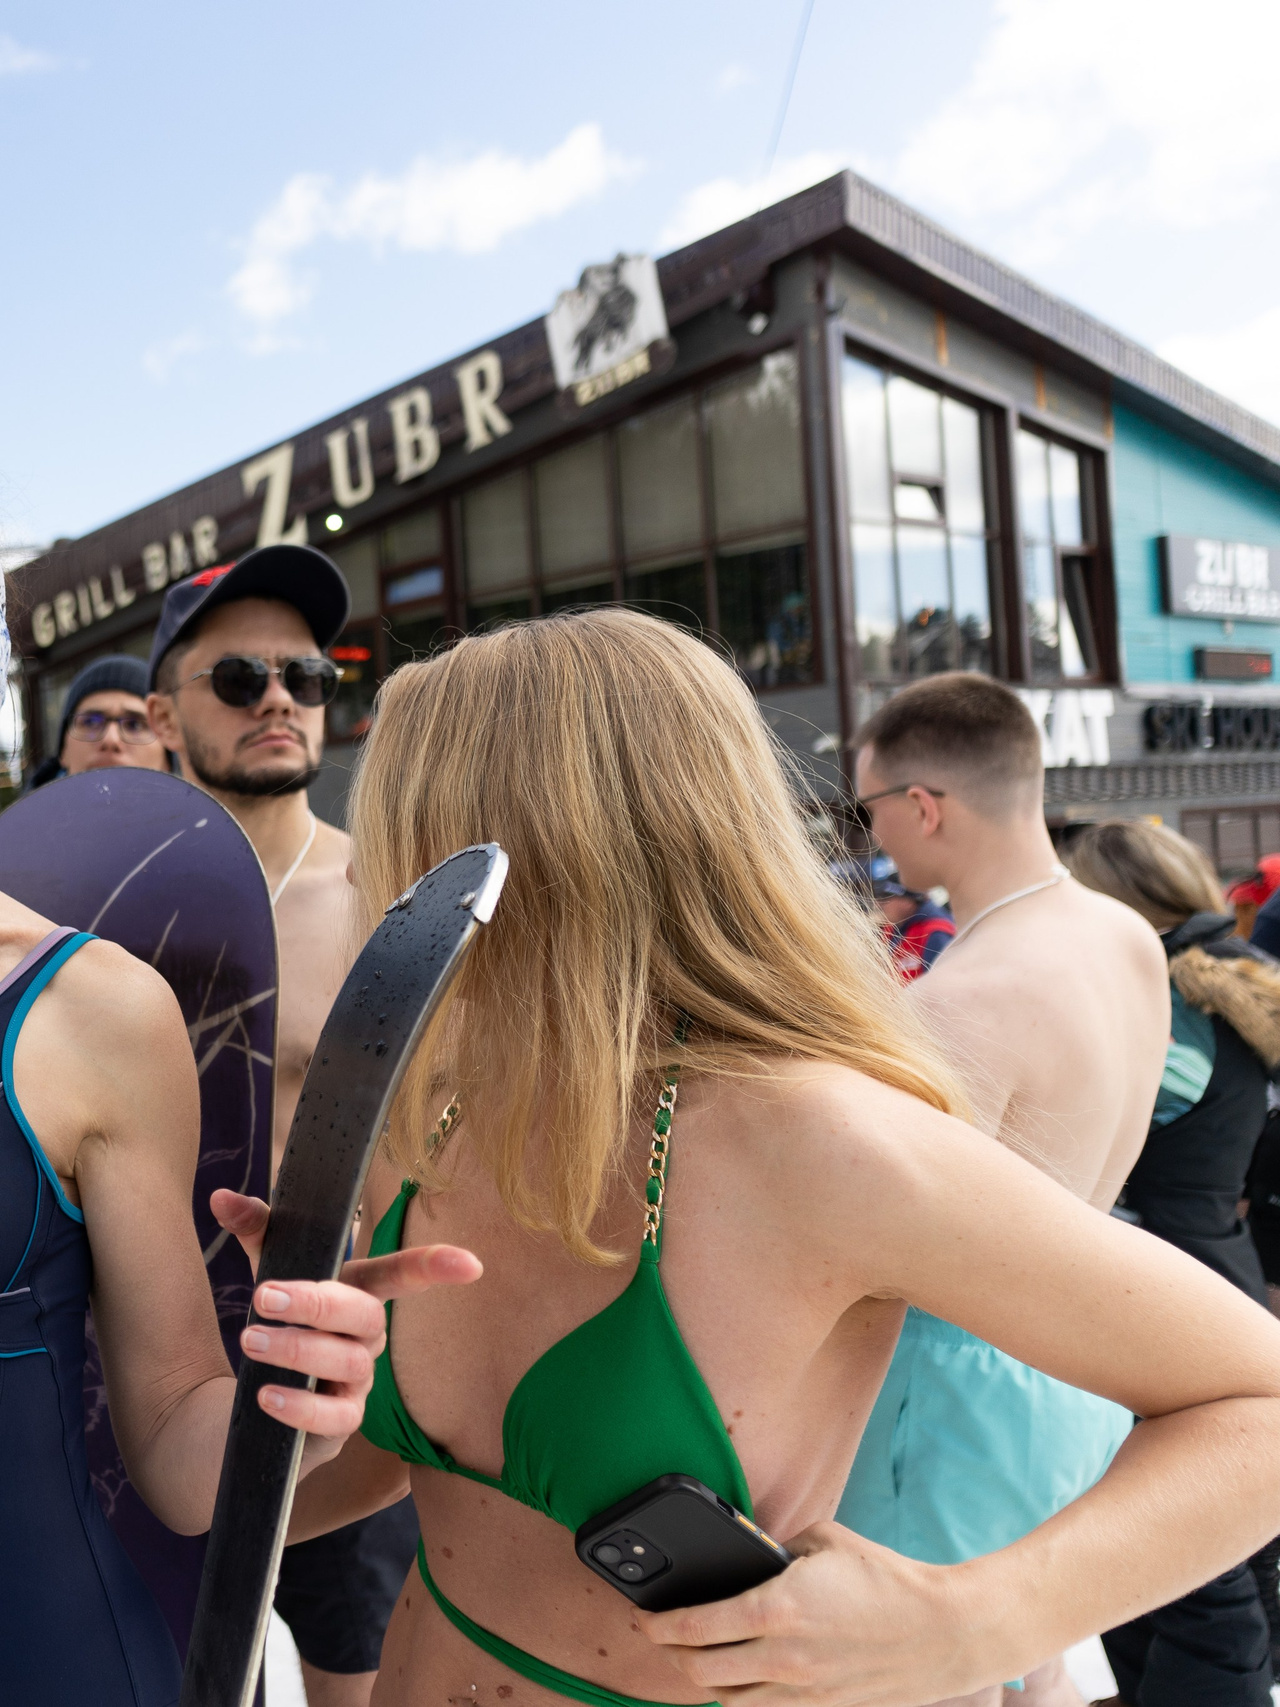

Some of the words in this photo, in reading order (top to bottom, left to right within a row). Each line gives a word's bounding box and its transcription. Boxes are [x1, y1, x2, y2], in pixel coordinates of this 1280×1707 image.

[32, 564, 136, 648] GRILL
[142, 515, 219, 592] BAR
[240, 349, 513, 549] ZUBR
